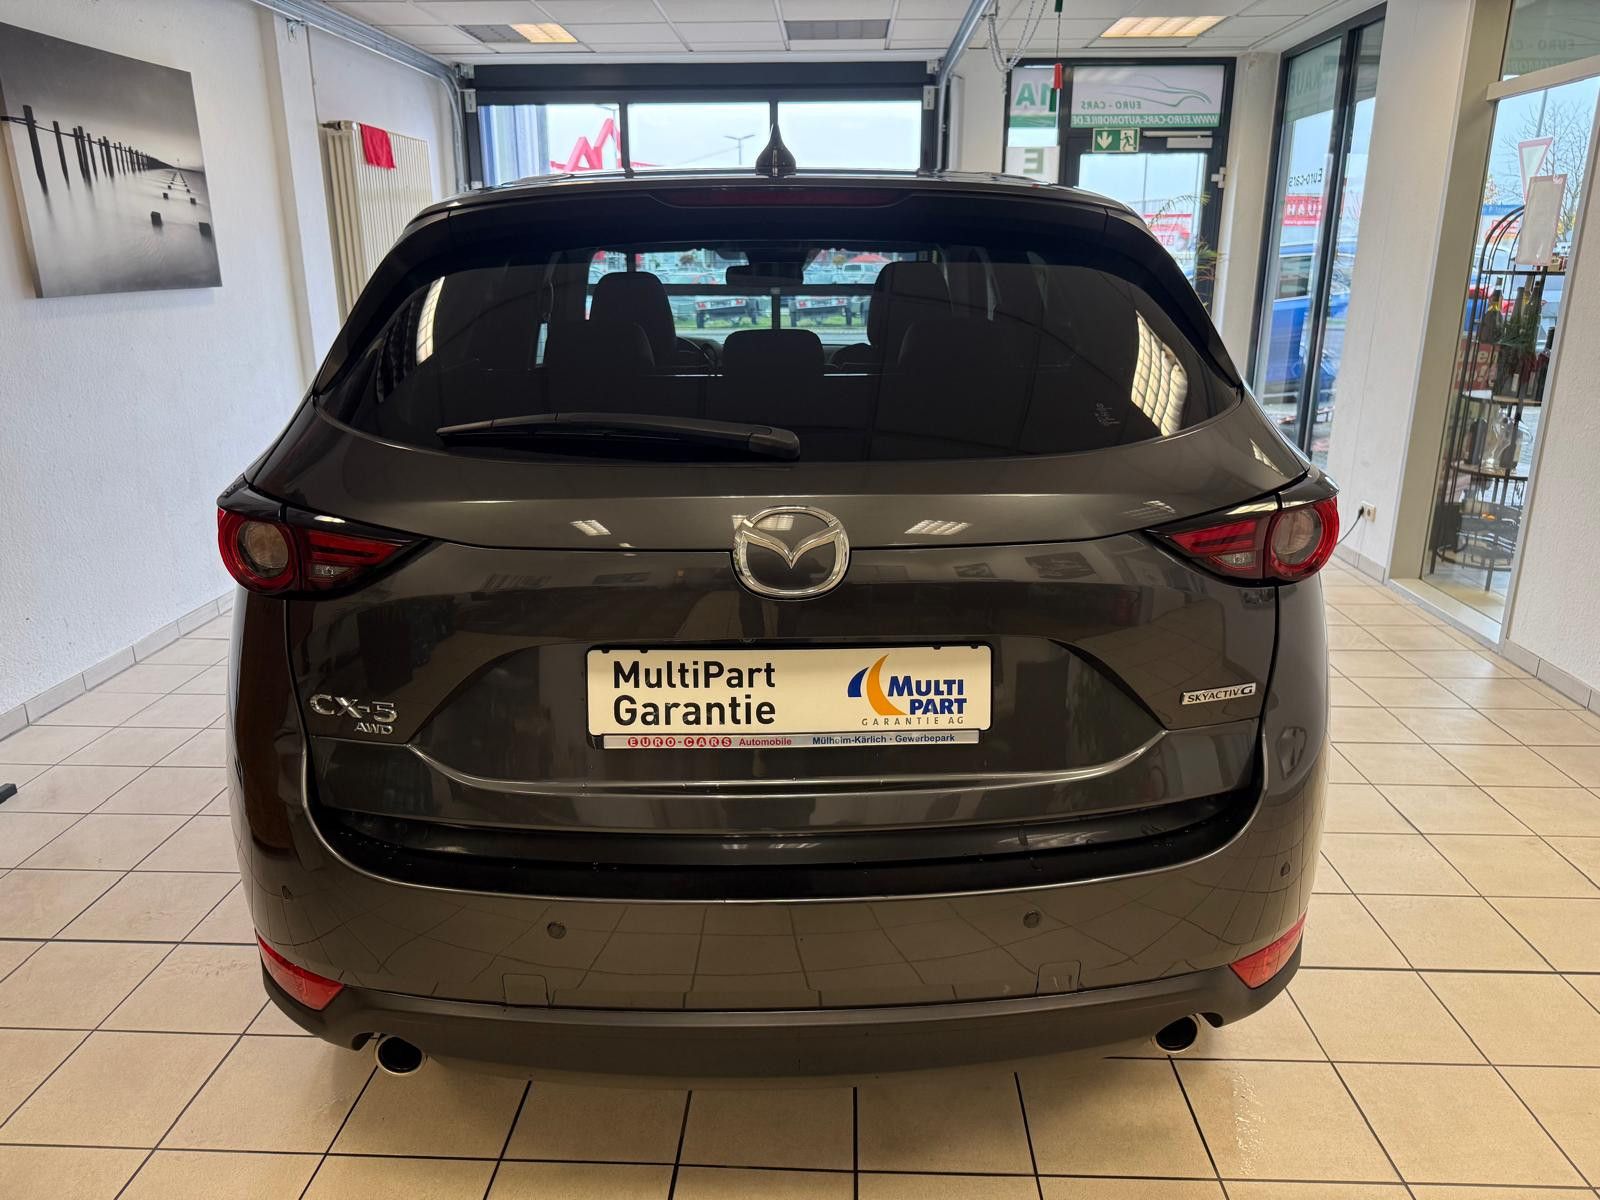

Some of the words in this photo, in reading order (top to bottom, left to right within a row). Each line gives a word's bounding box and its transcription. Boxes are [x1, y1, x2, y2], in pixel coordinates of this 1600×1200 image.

[613, 660, 776, 689] MultiPart
[309, 693, 398, 723] CX-5
[613, 694, 776, 726] Garantie
[909, 698, 967, 715] PART
[353, 721, 393, 735] AWD
[861, 716, 939, 726] GARANTIE
[947, 716, 964, 725] AG
[627, 736, 732, 748] EURO-CARS
[738, 737, 792, 746] Automobile
[812, 735, 887, 745] Mülheim-Kärlich
[894, 734, 955, 744] Gewerbepark
